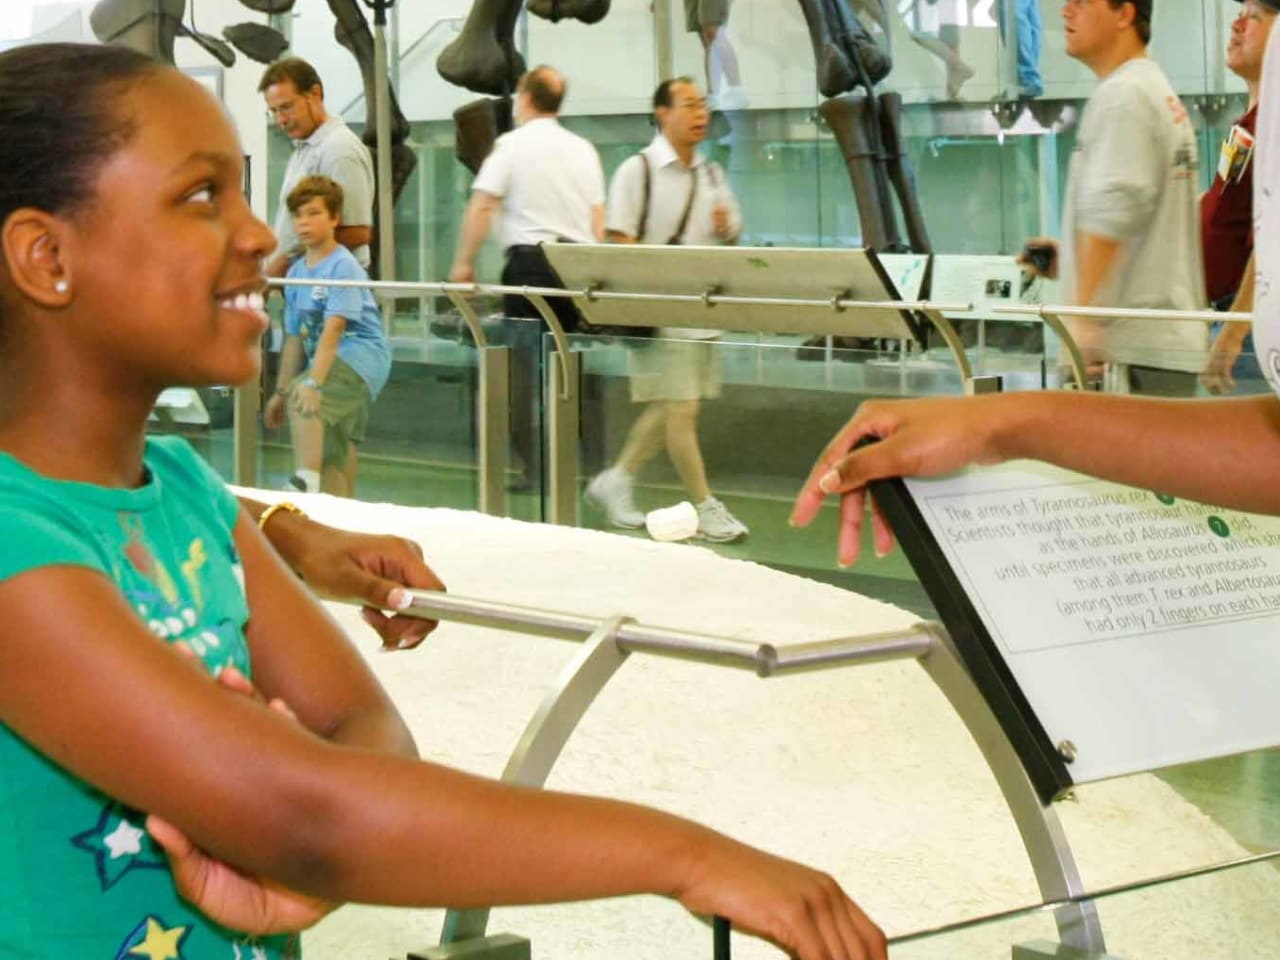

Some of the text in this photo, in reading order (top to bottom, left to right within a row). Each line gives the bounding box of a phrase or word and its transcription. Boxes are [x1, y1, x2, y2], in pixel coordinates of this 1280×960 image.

[944, 489, 1149, 521] The arms of Tyrannosaurus rex
[947, 524, 1016, 543] Scientists
[1018, 519, 1073, 538] thought
[1074, 515, 1105, 530] that
[1106, 507, 1180, 528] tyrannosaur
[1039, 541, 1055, 555] as
[1056, 537, 1081, 552] the
[1081, 531, 1119, 549] hands
[1122, 528, 1138, 544] of
[1141, 522, 1207, 541] Allosaurus
[994, 564, 1031, 581] until
[1032, 555, 1108, 579] specimens
[1111, 551, 1143, 566] were
[1220, 534, 1261, 552] which
[1072, 554, 1268, 592] that all advanced tyrannosaurs
[1056, 596, 1113, 616] (among
[1111, 591, 1149, 608] them
[1164, 588, 1184, 601] rex
[1187, 580, 1215, 597] and
[1084, 615, 1117, 632] had
[1118, 611, 1146, 630] only
[1146, 608, 1156, 625] 2
[1158, 604, 1206, 624] fingers
[1208, 601, 1228, 615] on
[1229, 595, 1262, 611] each
